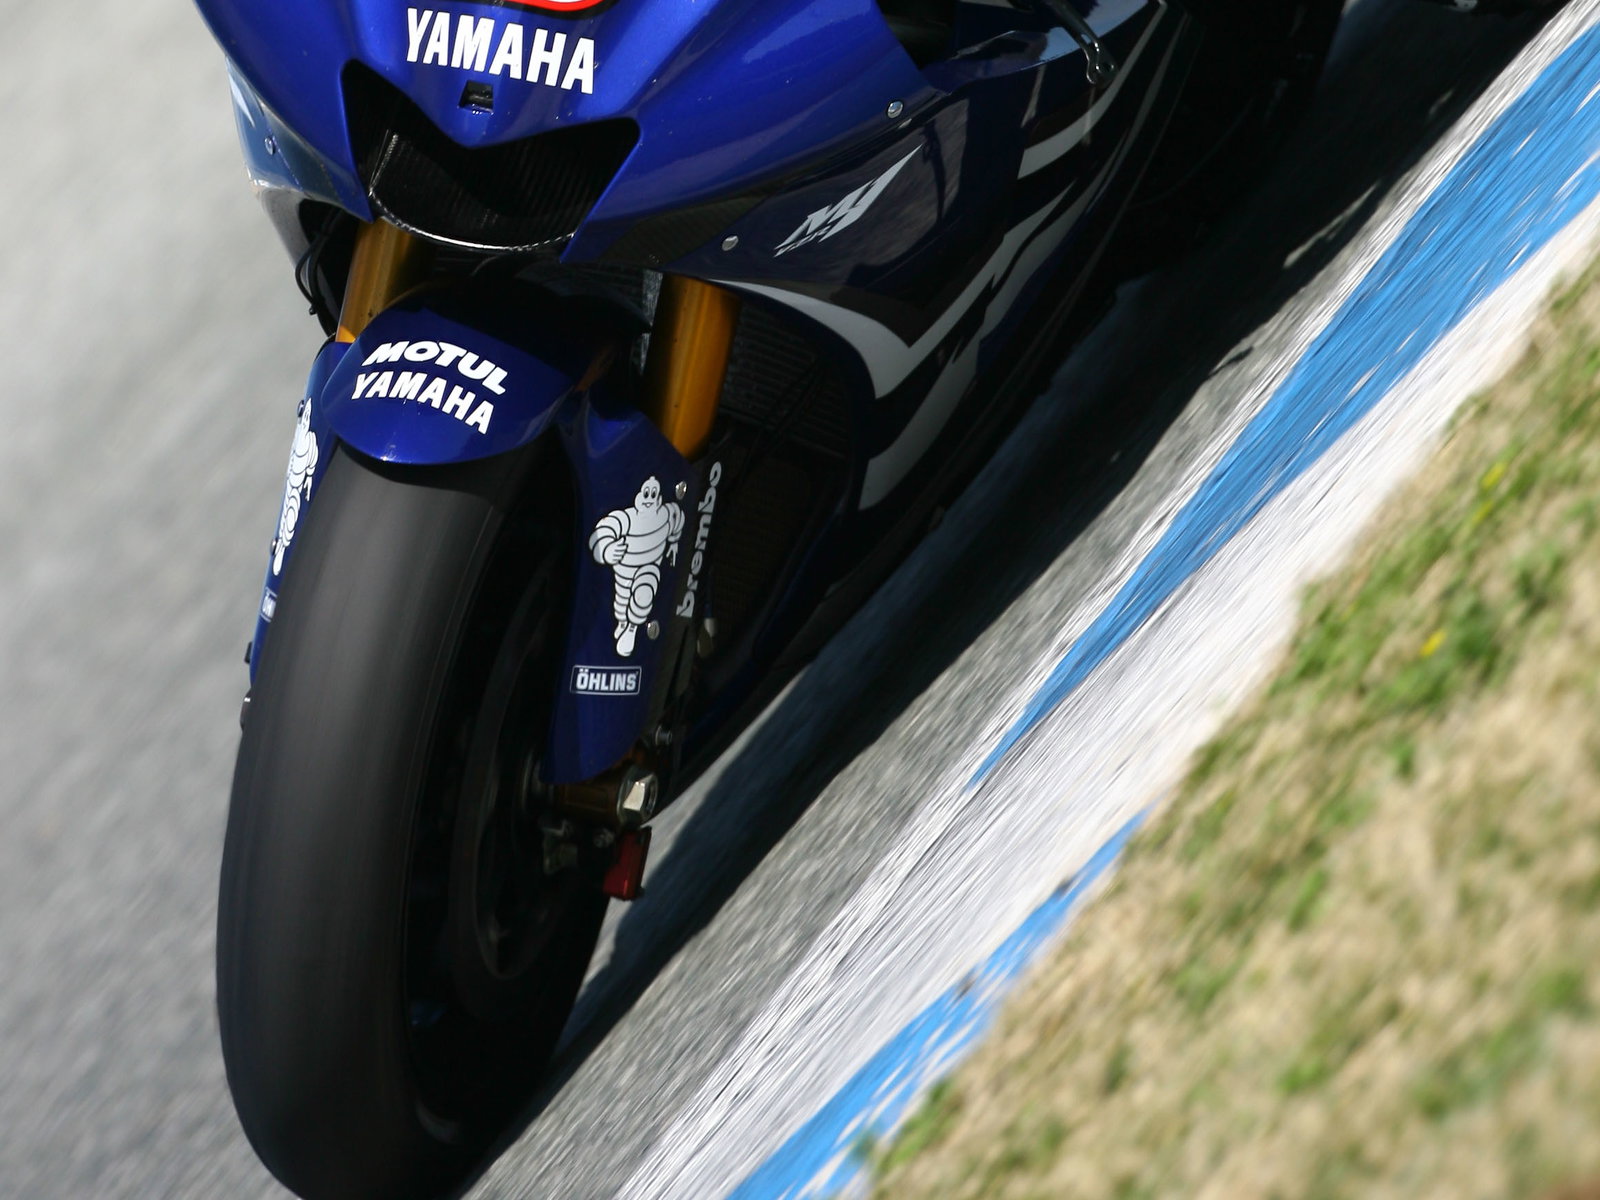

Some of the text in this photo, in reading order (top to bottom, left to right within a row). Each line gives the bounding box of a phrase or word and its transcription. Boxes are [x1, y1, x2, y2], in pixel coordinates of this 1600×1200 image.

[406, 7, 595, 95] YAMAHA
[361, 340, 508, 395] MOTUL
[351, 371, 494, 435] YAMAHA
[676, 461, 722, 618] brembo
[575, 668, 637, 692] ÖHLINS
